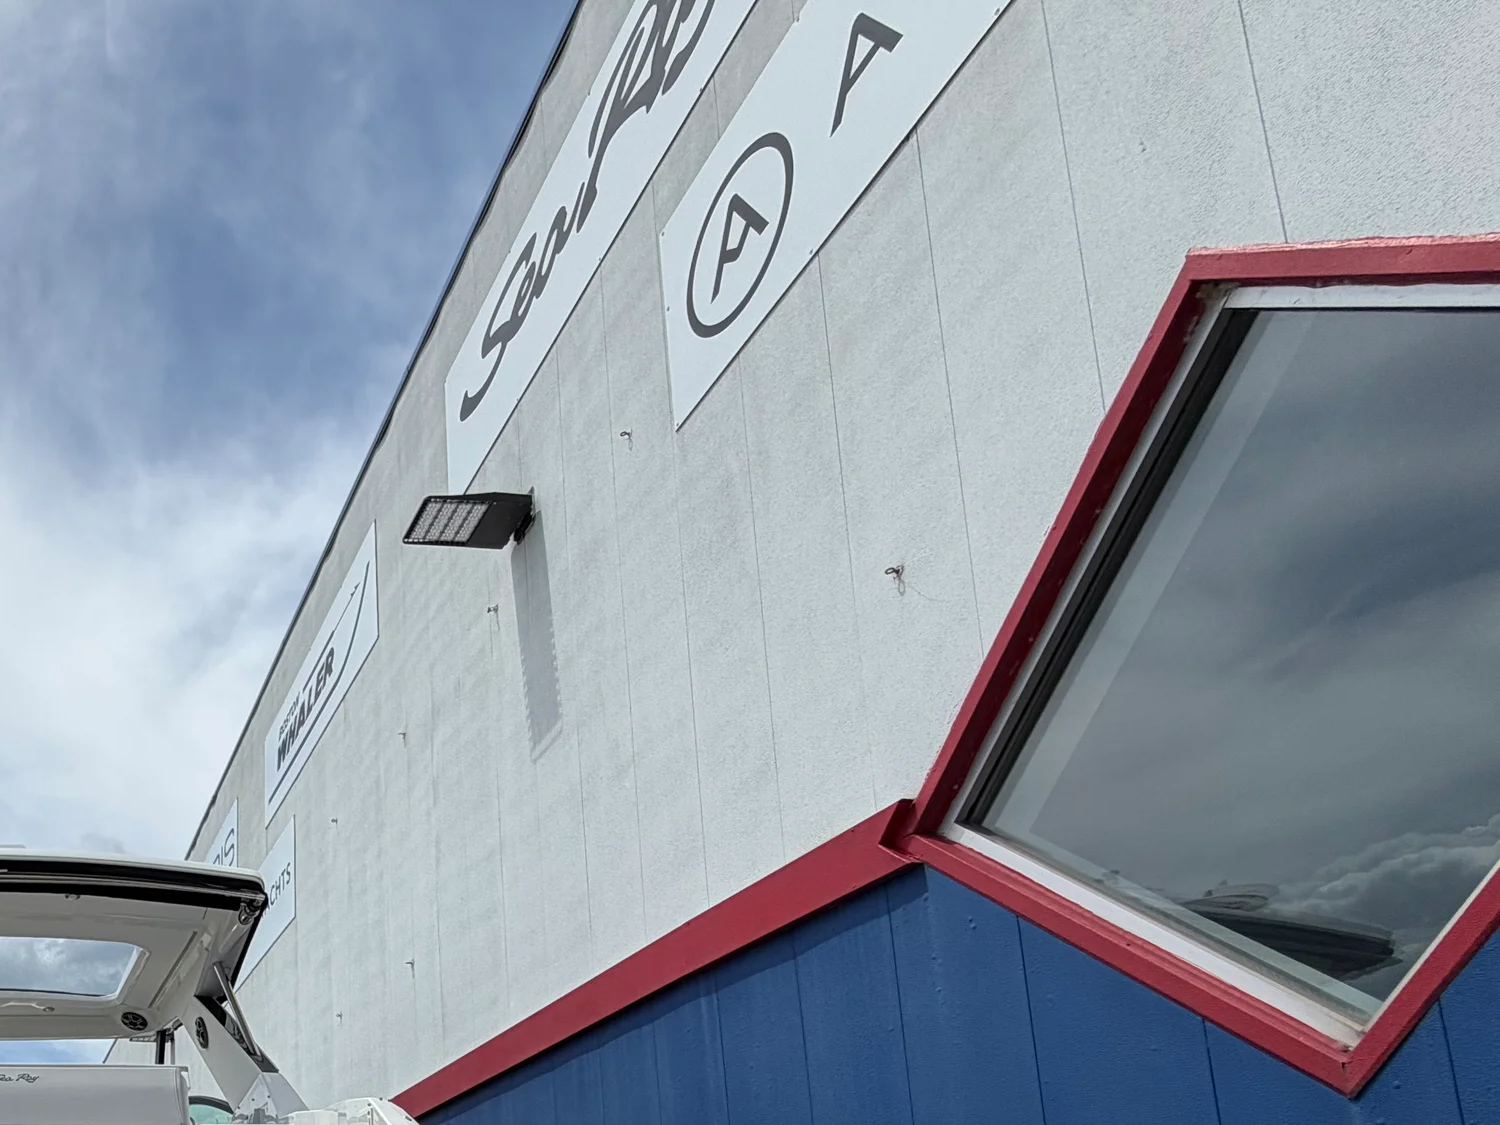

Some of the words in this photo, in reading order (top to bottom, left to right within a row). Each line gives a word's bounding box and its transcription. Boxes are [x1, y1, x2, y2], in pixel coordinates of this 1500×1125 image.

[460, 181, 584, 422] Sea
[277, 646, 335, 772] WHALER
[15, 1073, 40, 1083] Ray
